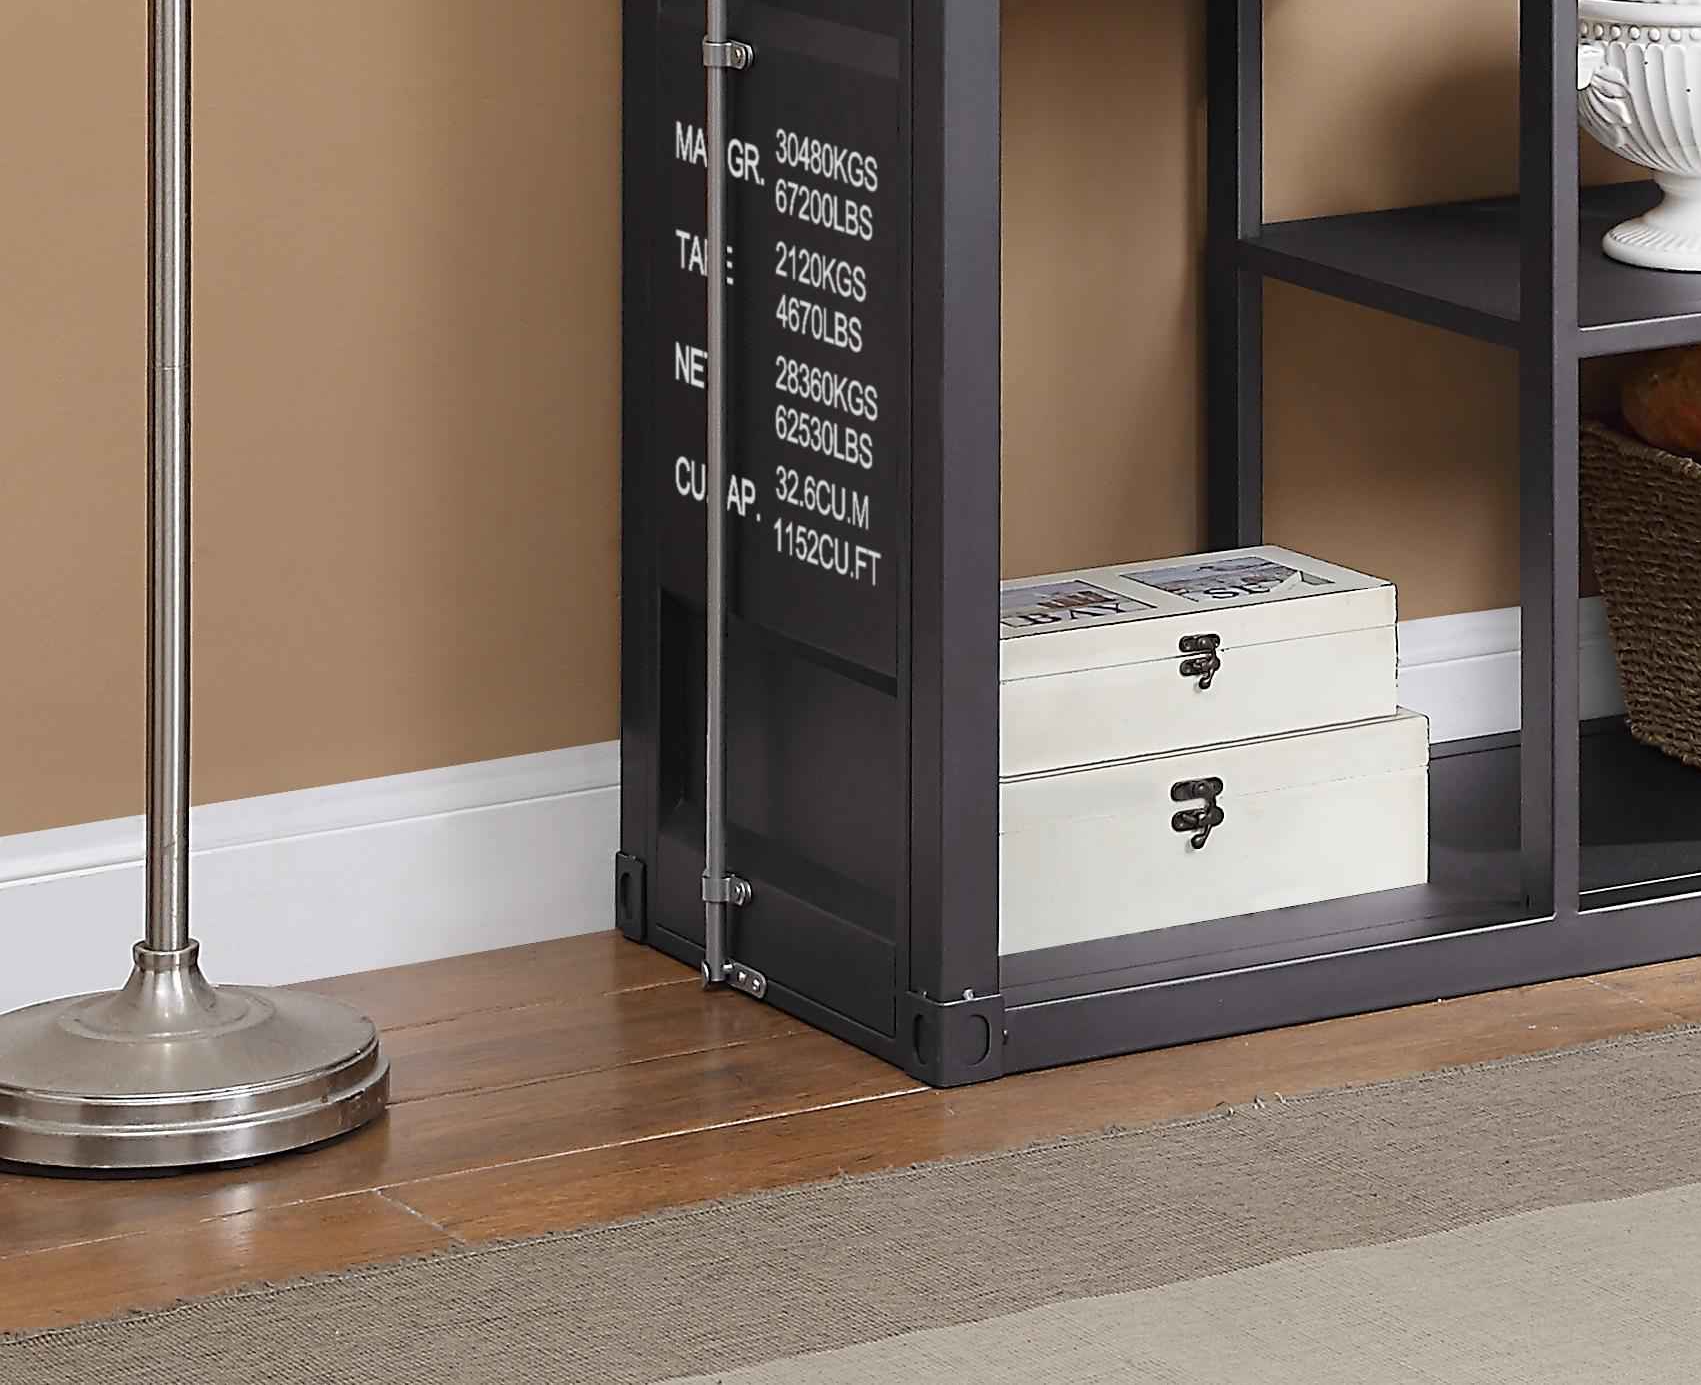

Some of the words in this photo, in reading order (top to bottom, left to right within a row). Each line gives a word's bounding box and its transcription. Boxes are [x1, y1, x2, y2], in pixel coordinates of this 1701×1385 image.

[675, 120, 708, 168] MA
[727, 138, 765, 186] GR.
[775, 128, 878, 193] 30480KGS
[775, 178, 873, 241] 67200LBS
[775, 240, 867, 303] 2120KGS
[775, 293, 863, 353] 4670LBS
[675, 341, 708, 389] NE
[775, 354, 879, 422] 28360KGS
[775, 404, 873, 470] 62530LBS
